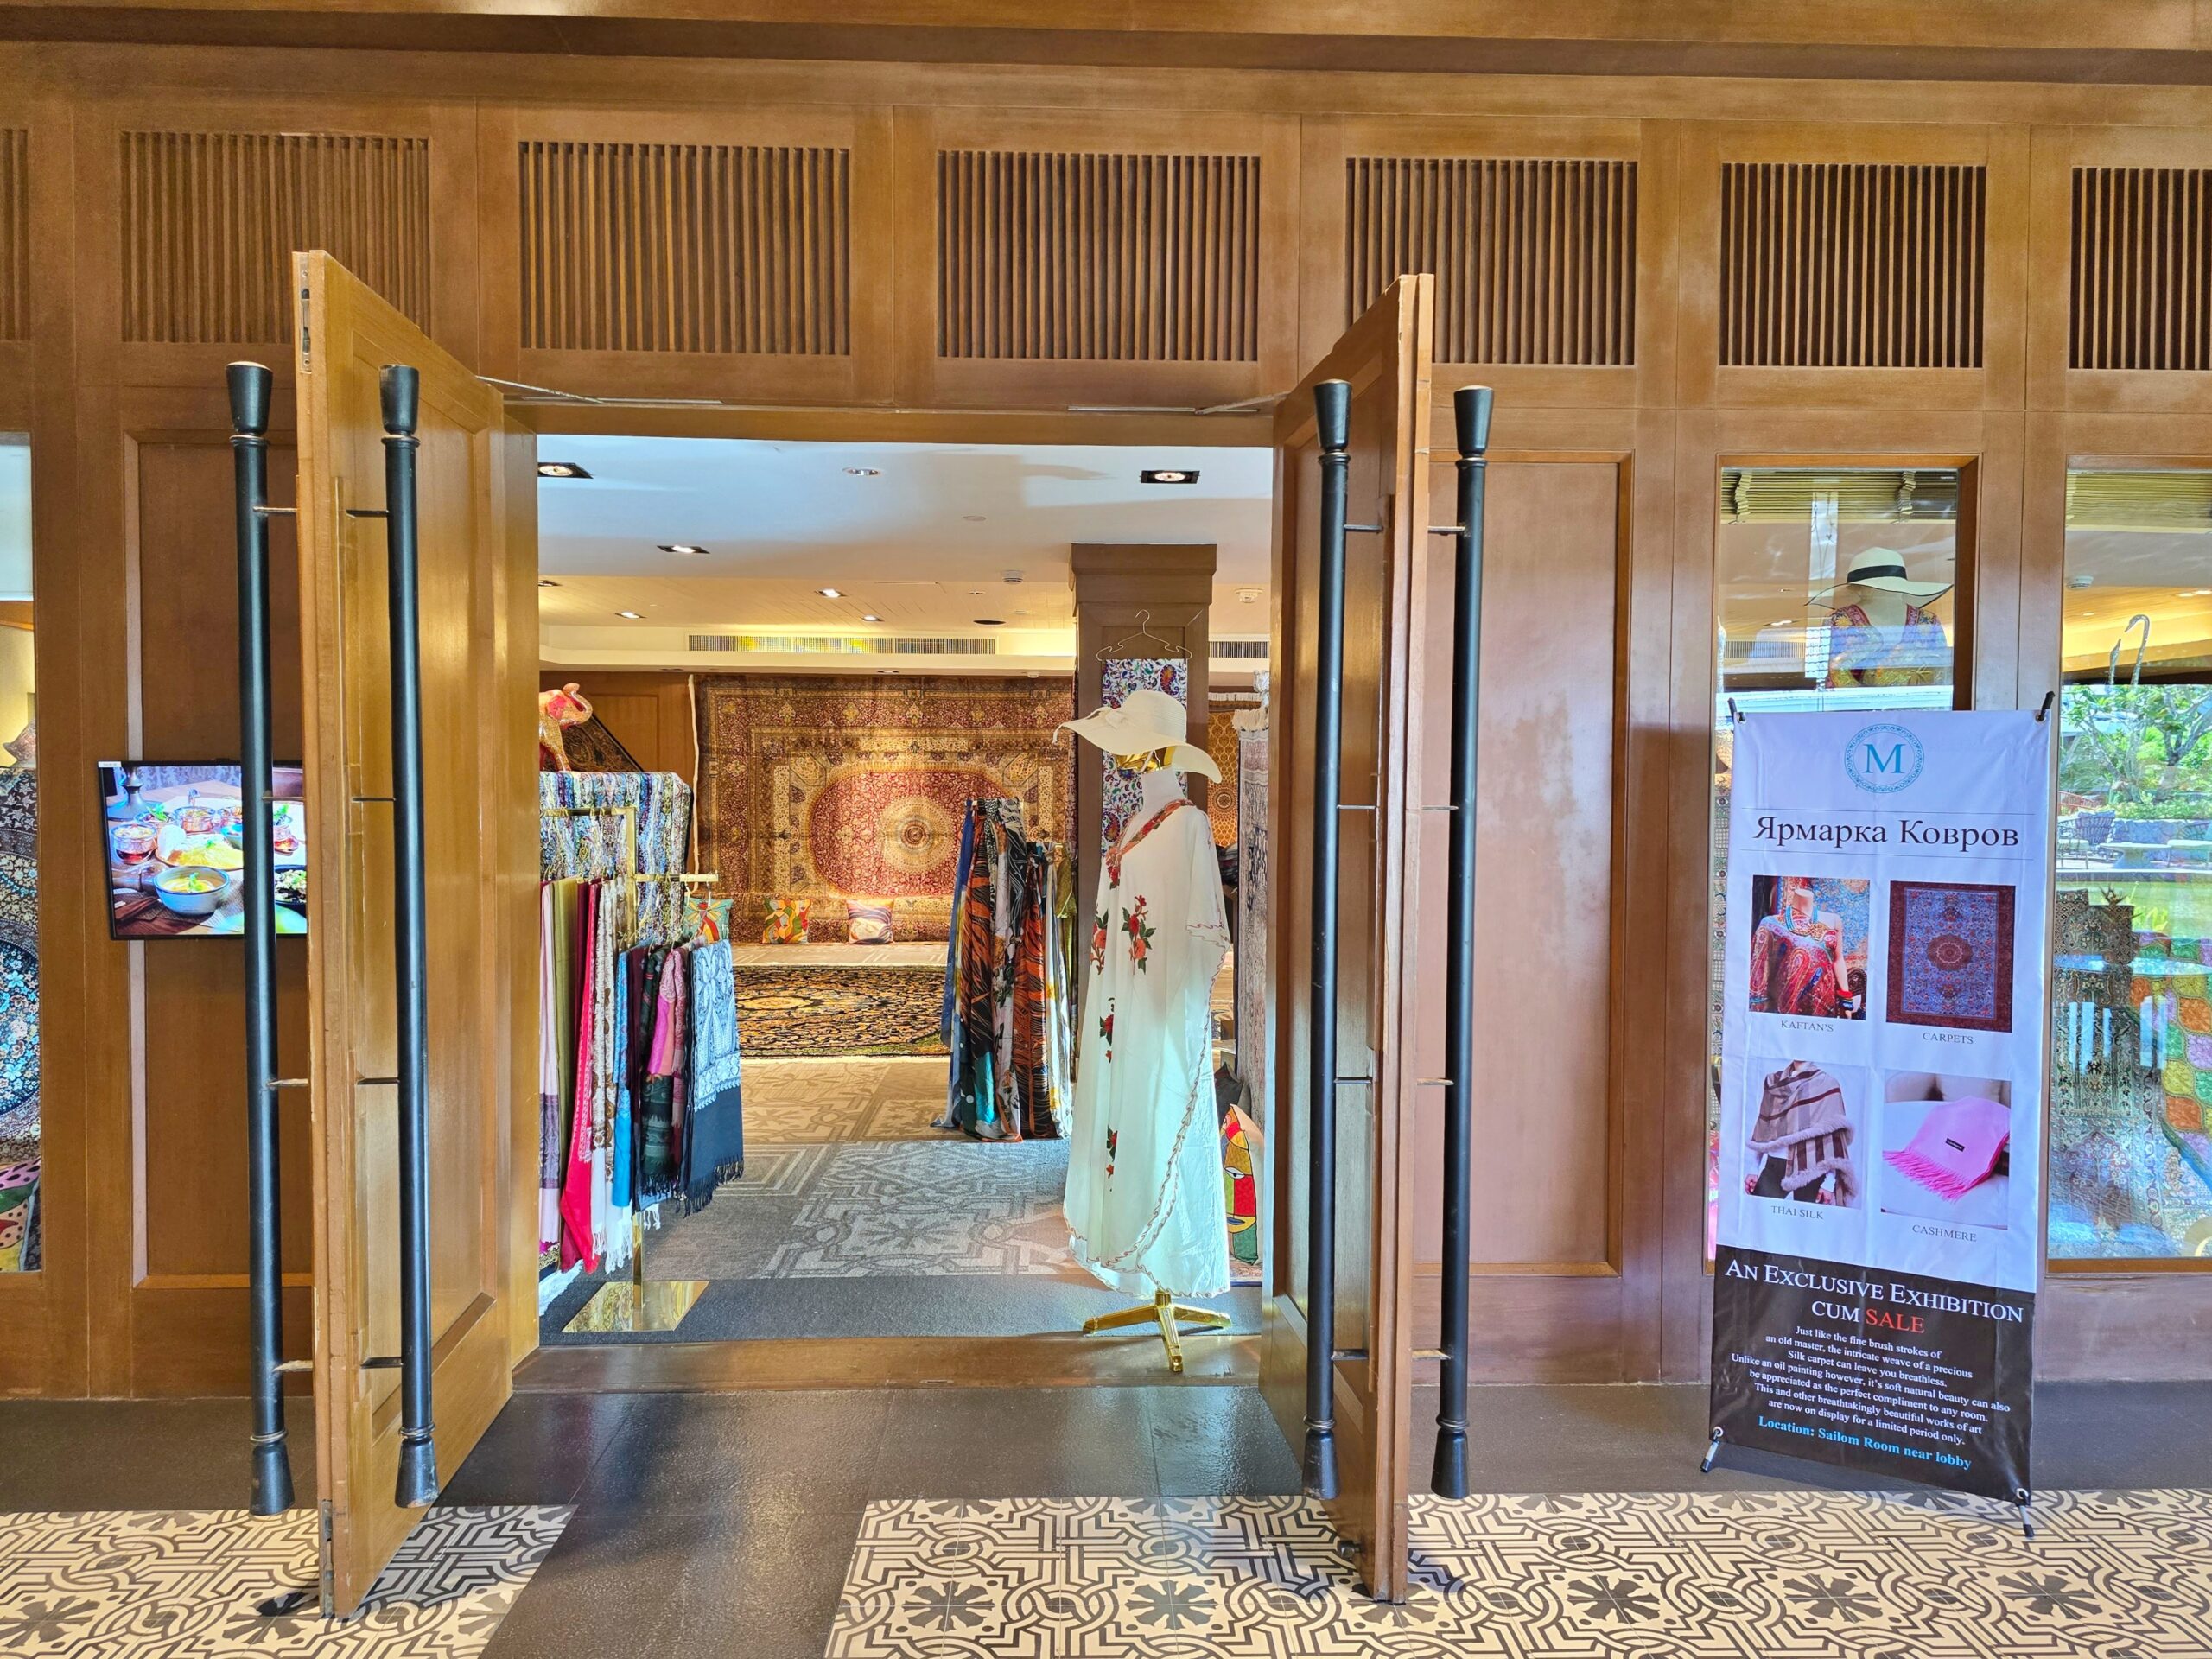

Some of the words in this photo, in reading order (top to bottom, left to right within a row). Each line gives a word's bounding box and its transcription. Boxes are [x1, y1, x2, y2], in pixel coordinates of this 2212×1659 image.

[1862, 743, 1905, 773] M
[1752, 816, 1886, 849] Ярмарка
[1898, 819, 2019, 852] Ковров
[1923, 1032, 1974, 1045] CARPETS
[1770, 1205, 1797, 1217] THAI
[1799, 1208, 1823, 1220] SILK
[1912, 1224, 1977, 1243] CASHMERE
[1725, 1260, 1758, 1281] AN
[1764, 1264, 1884, 1300] EXCLUSIVE
[1889, 1283, 2024, 1323] EXHIBITION
[1812, 1301, 1859, 1323] CUM
[1866, 1308, 1925, 1333] SALE
[1778, 1336, 1792, 1345] old
[1795, 1339, 1826, 1352] master,
[1827, 1344, 1841, 1354] the
[1844, 1348, 1879, 1362] intricate
[1883, 1356, 1910, 1367] weave
[1934, 1364, 1973, 1378] precious
[1796, 1326, 1813, 1337] Just
[1815, 1329, 1832, 1339] like
[1834, 1332, 1847, 1343] the
[1850, 1335, 1866, 1346] fine
[1869, 1338, 1893, 1351] brush
[1897, 1346, 1928, 1357] strokes
[1930, 1351, 1942, 1359] of
[1732, 1354, 1760, 1365] Unlike
[1775, 1362, 1785, 1370] oil
[1788, 1364, 1823, 1379] painting
[1826, 1370, 1866, 1386] however,
[1885, 1382, 1903, 1392] soft
[1904, 1386, 1936, 1398] natural
[1938, 1392, 1969, 1405] beauty
[1972, 1400, 1987, 1408] can
[1991, 1402, 2011, 1412] also
[1788, 1351, 1805, 1361] Silk
[1808, 1356, 1834, 1366] carpet
[1836, 1361, 1851, 1370] can
[1854, 1363, 1877, 1374] leave
[1899, 1371, 1947, 1387] breathless.
[1750, 1370, 1760, 1378] be
[1762, 1372, 1810, 1388] appreciated
[1825, 1382, 1839, 1393] the
[1840, 1388, 1871, 1399] perfect
[1873, 1393, 1927, 1410] compliment
[1929, 1403, 1939, 1412] to
[1941, 1408, 1958, 1417] any
[1961, 1411, 1988, 1422] room.
[1755, 1382, 1773, 1394] This
[1776, 1388, 1790, 1397] and
[1793, 1391, 1815, 1402] other
[1818, 1395, 1880, 1416] breathtakingly
[1883, 1408, 1923, 1423] beautiful
[1926, 1416, 1955, 1427] works
[1957, 1422, 1967, 1431] of
[1769, 1399, 1782, 1408] are
[1784, 1402, 1802, 1412] now
[1818, 1408, 1850, 1424] display
[1853, 1415, 1866, 1425] for
[1876, 1419, 1907, 1433] limited
[1910, 1427, 1939, 1440] period
[1942, 1433, 1966, 1446] only.
[1758, 1415, 1815, 1436] Location:
[1818, 1427, 1859, 1446] Sailom
[1864, 1437, 1899, 1454] Room
[1904, 1446, 1932, 1460] near
[1936, 1452, 1972, 1470] lobby
